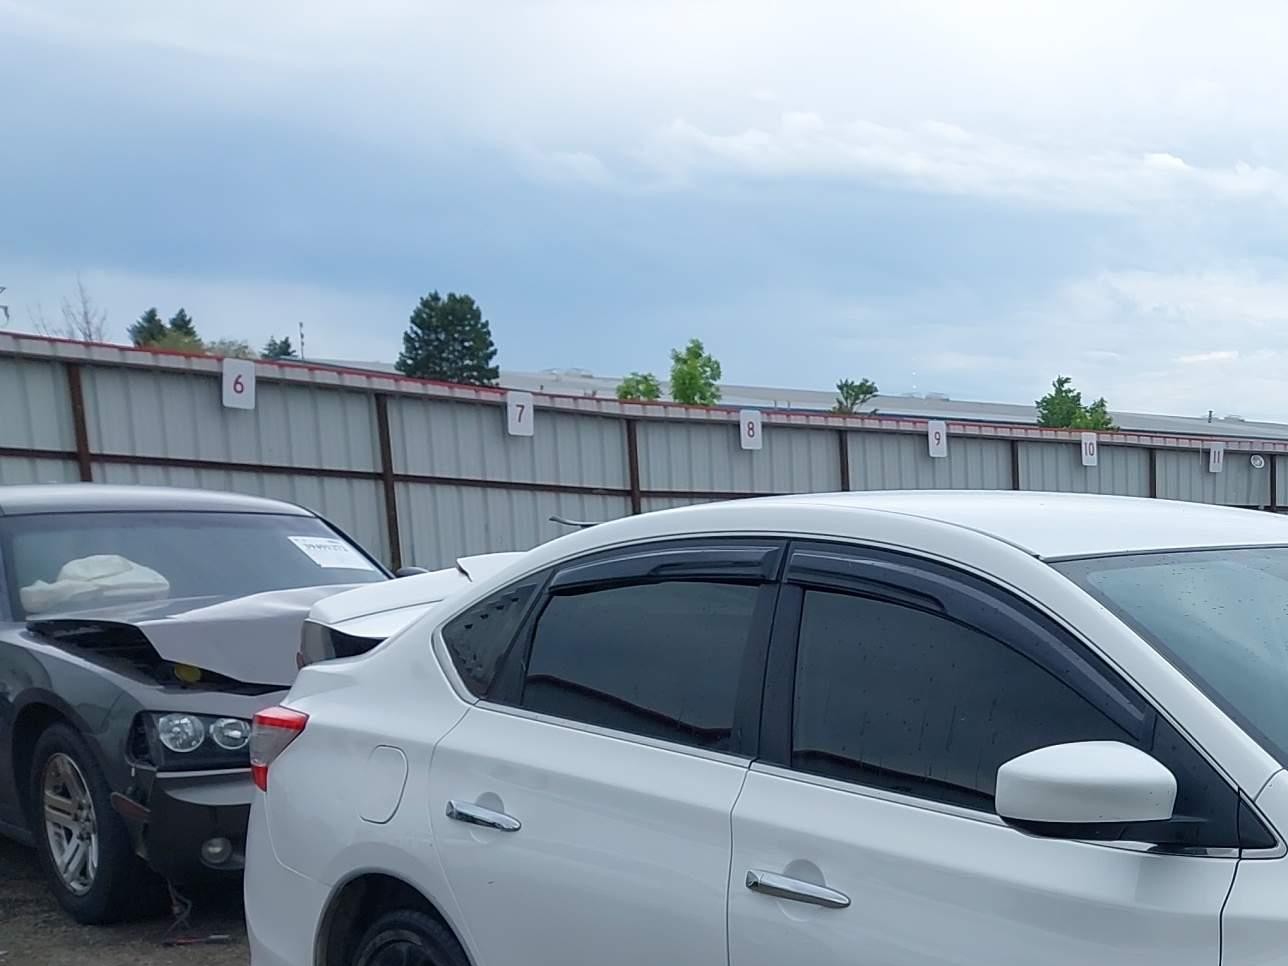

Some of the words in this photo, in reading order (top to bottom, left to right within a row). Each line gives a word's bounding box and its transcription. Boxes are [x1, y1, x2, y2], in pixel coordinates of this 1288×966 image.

[233, 373, 244, 394] 6
[515, 404, 525, 423] 7
[747, 420, 755, 438] 8
[934, 431, 941, 446] 9
[1084, 441, 1095, 457] 10
[1213, 449, 1220, 464] 11
